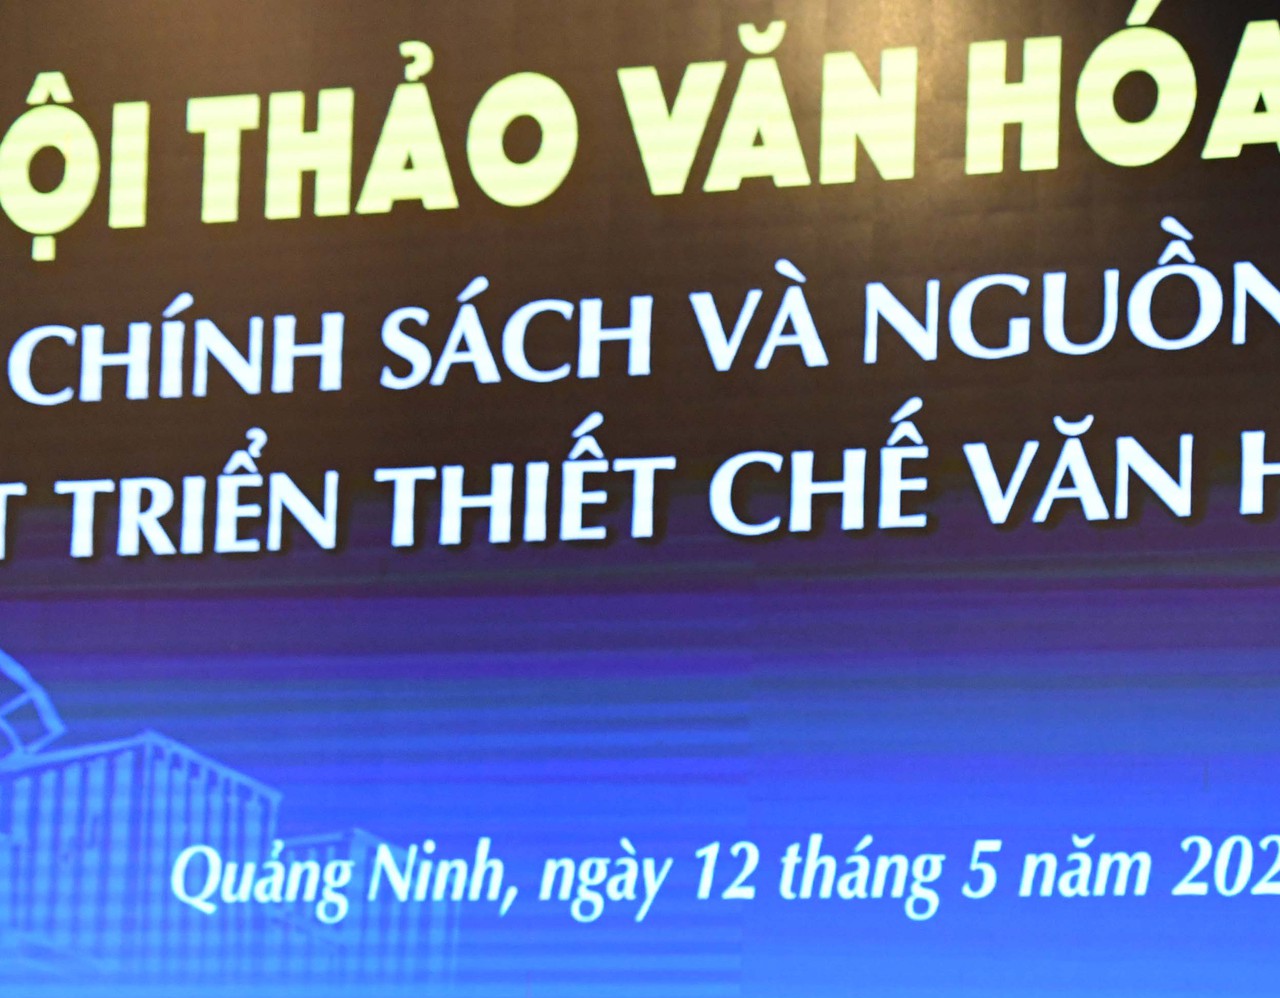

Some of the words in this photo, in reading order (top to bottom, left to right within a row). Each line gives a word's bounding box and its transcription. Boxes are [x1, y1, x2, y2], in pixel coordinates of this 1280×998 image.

[186, 40, 578, 223] THẢO
[617, 20, 919, 196] VĂN
[7, 292, 345, 406] CHÍNH
[379, 276, 654, 390] SÁCH
[689, 258, 830, 371] VÀ
[54, 427, 340, 558] TRIỂN
[374, 411, 677, 547] THIẾT
[708, 396, 929, 536] CHẾ
[963, 413, 1194, 525] VĂN
[170, 838, 354, 924] Quảng
[368, 836, 518, 916] Ninh,
[539, 836, 674, 922] ngày
[695, 840, 761, 900] 12
[778, 832, 947, 921] tháng
[961, 838, 1003, 900] 5
[1017, 833, 1153, 899] năm
